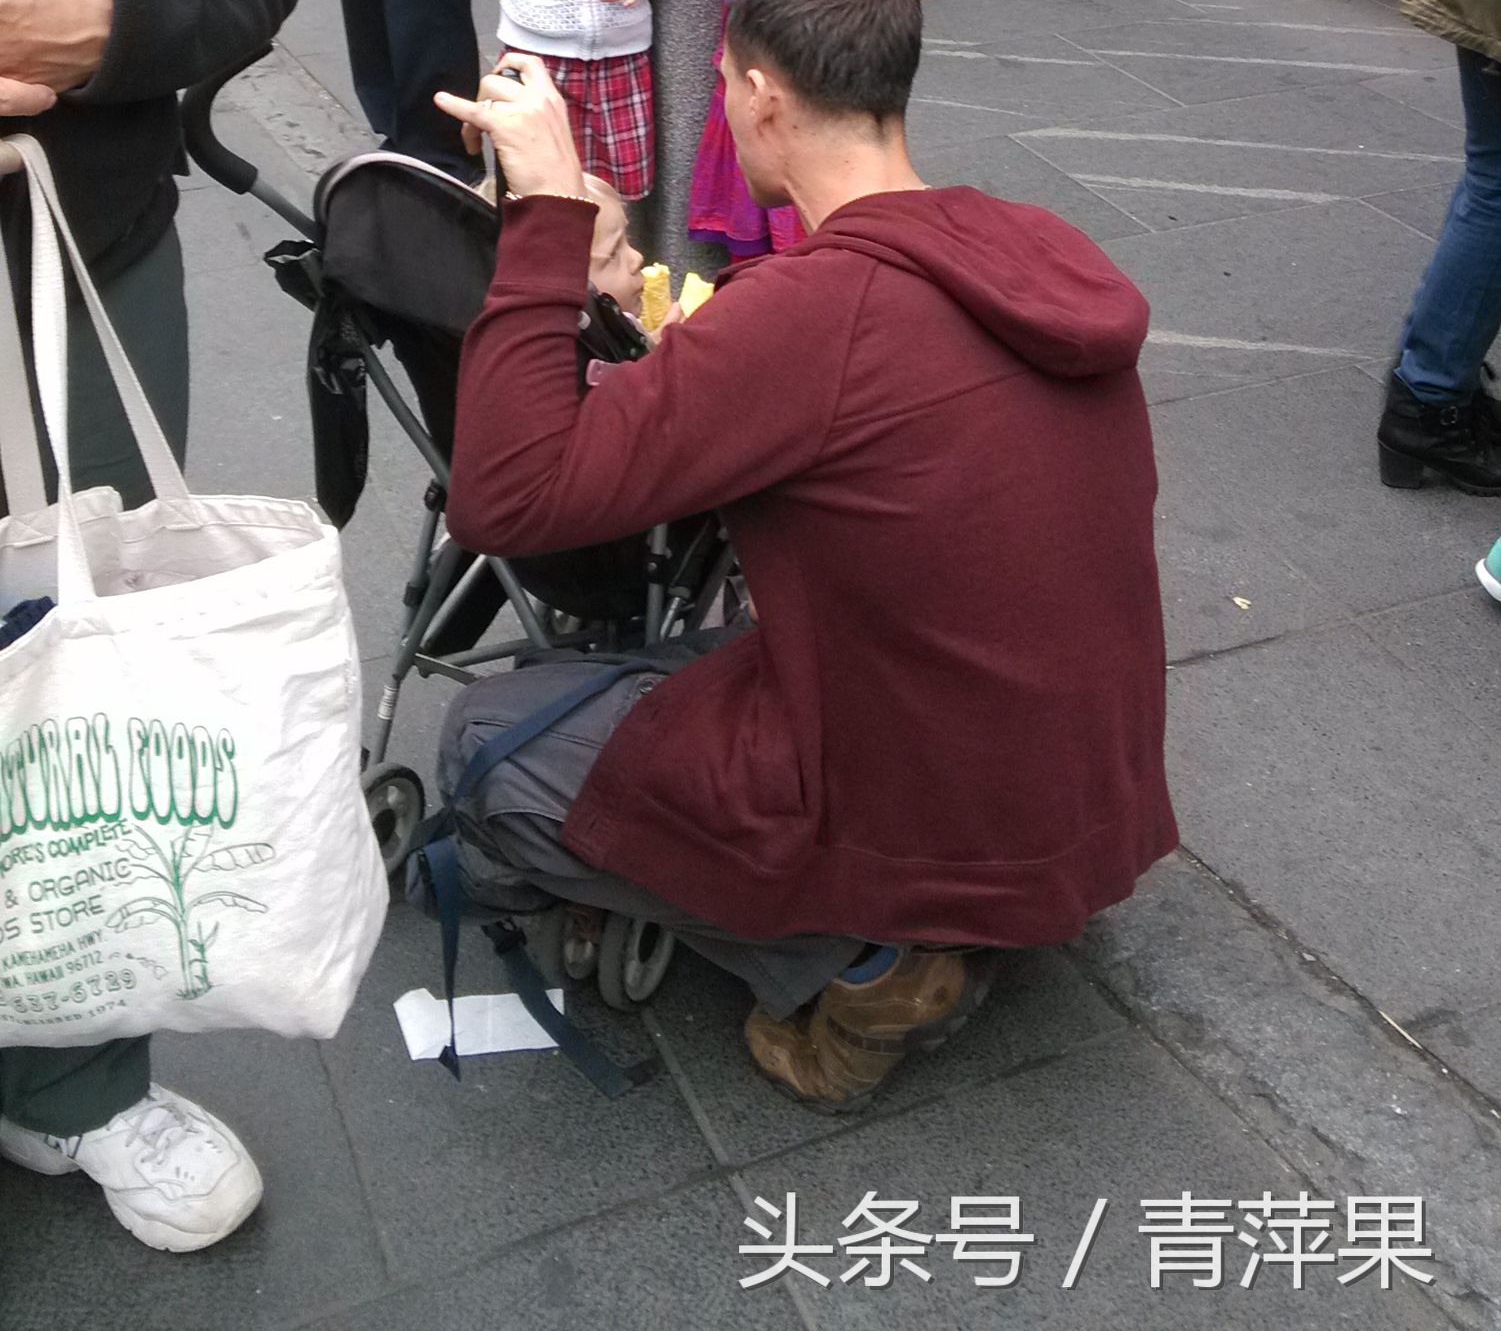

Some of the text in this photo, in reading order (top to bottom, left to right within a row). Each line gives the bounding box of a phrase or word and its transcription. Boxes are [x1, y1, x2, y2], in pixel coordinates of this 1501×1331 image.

[127, 717, 239, 830] FOODS
[48, 819, 132, 859] COMPLETE
[4, 857, 133, 909] & ORGANIC
[30, 894, 106, 935] STORE
[65, 950, 104, 974] 96712
